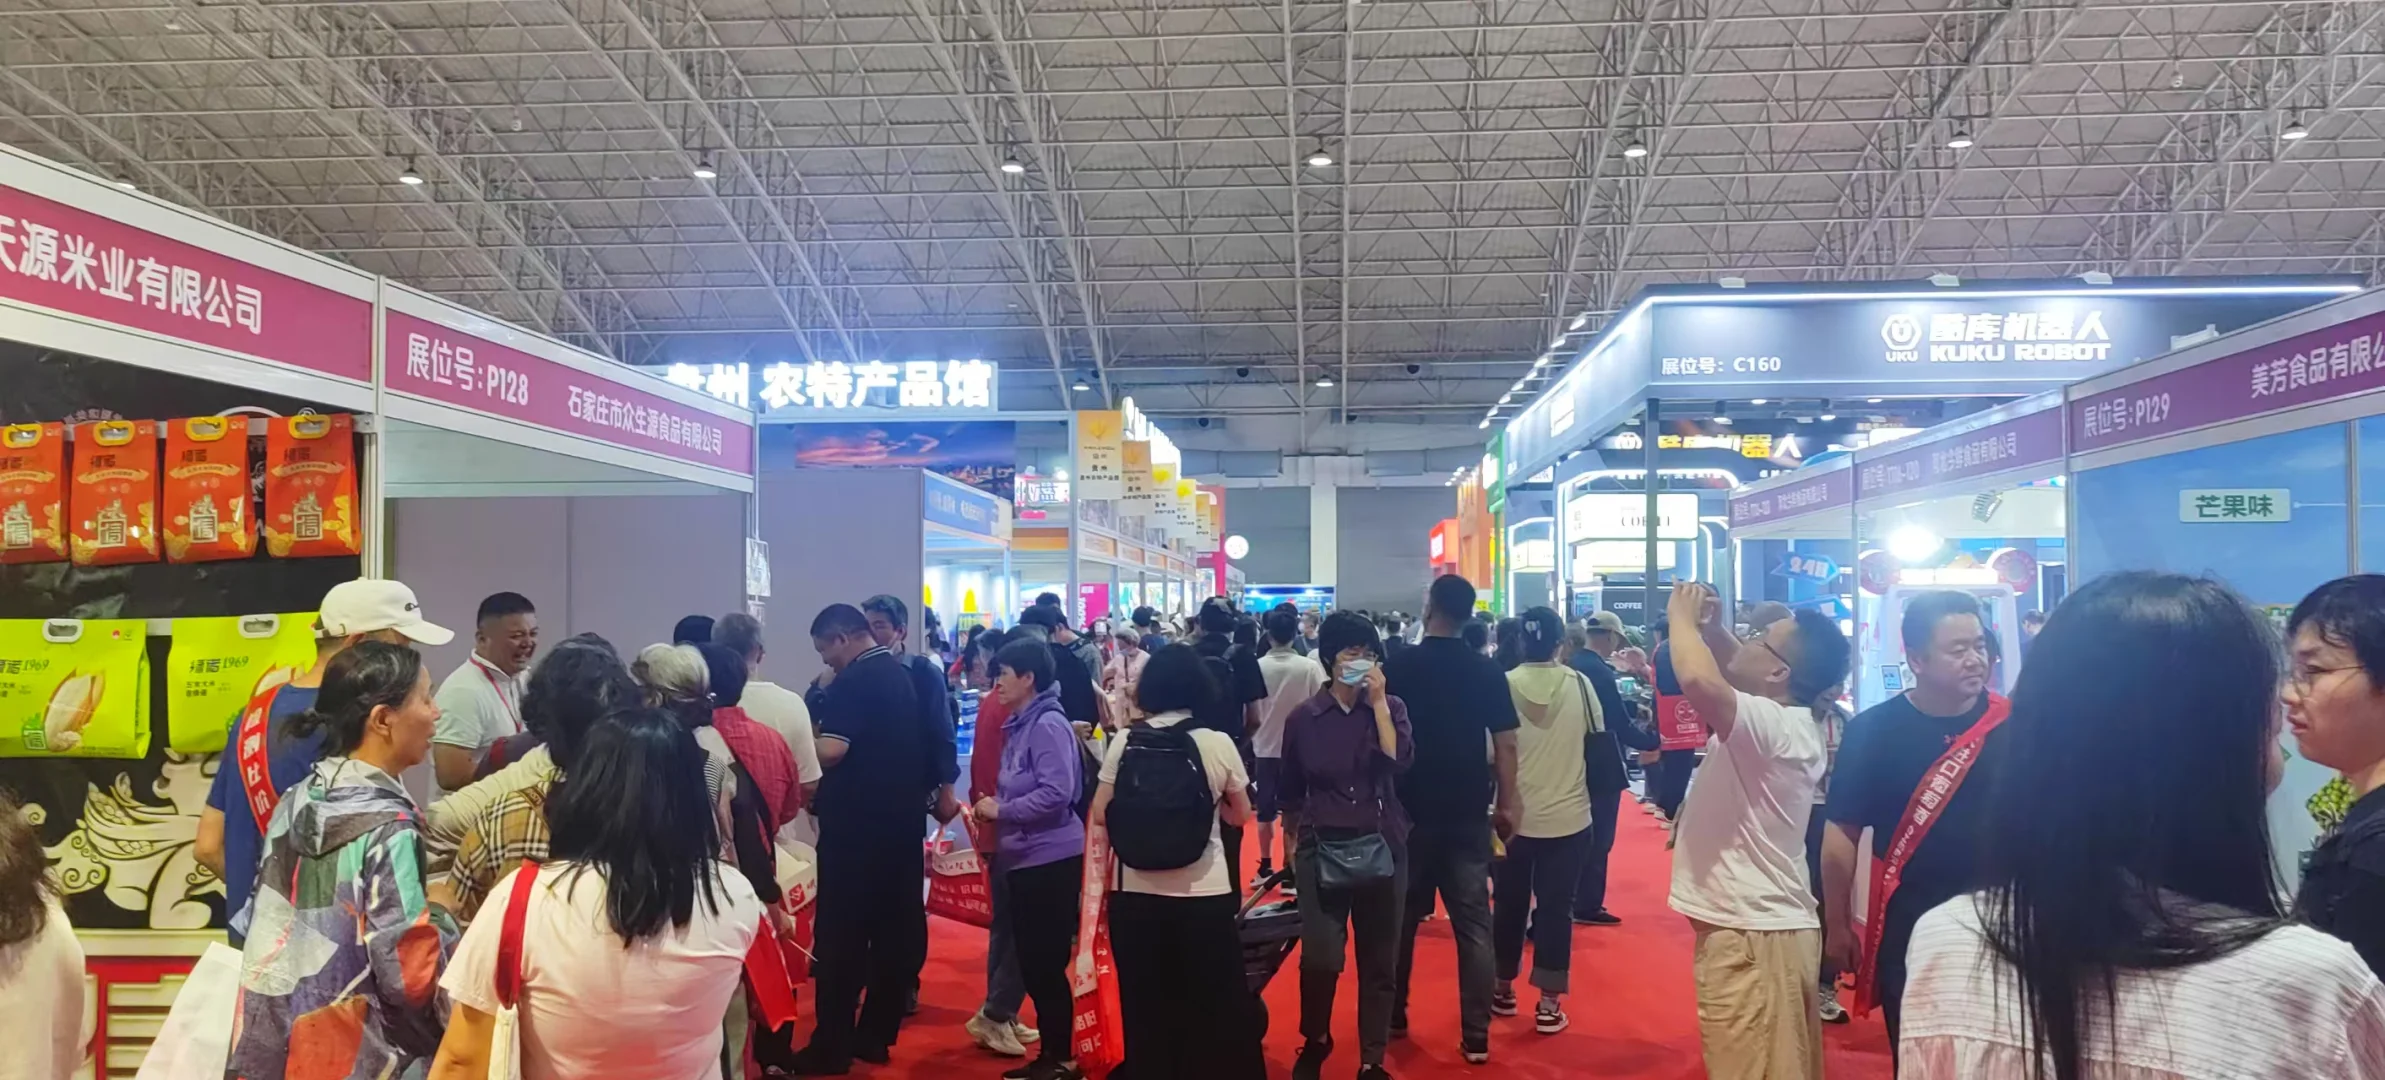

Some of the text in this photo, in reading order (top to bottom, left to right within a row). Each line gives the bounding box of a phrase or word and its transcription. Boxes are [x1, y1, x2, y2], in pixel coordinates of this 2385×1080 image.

[1929, 310, 2110, 342] 酷库机器人
[1885, 351, 1919, 363] UKU
[1930, 343, 2111, 362] KUKU ROBOT
[759, 359, 992, 410] 农特产品馆
[567, 384, 723, 457] 石家庄市众生源食品有限公司
[2194, 493, 2273, 519] 芒果味
[1613, 602, 1643, 610] COFFEE
